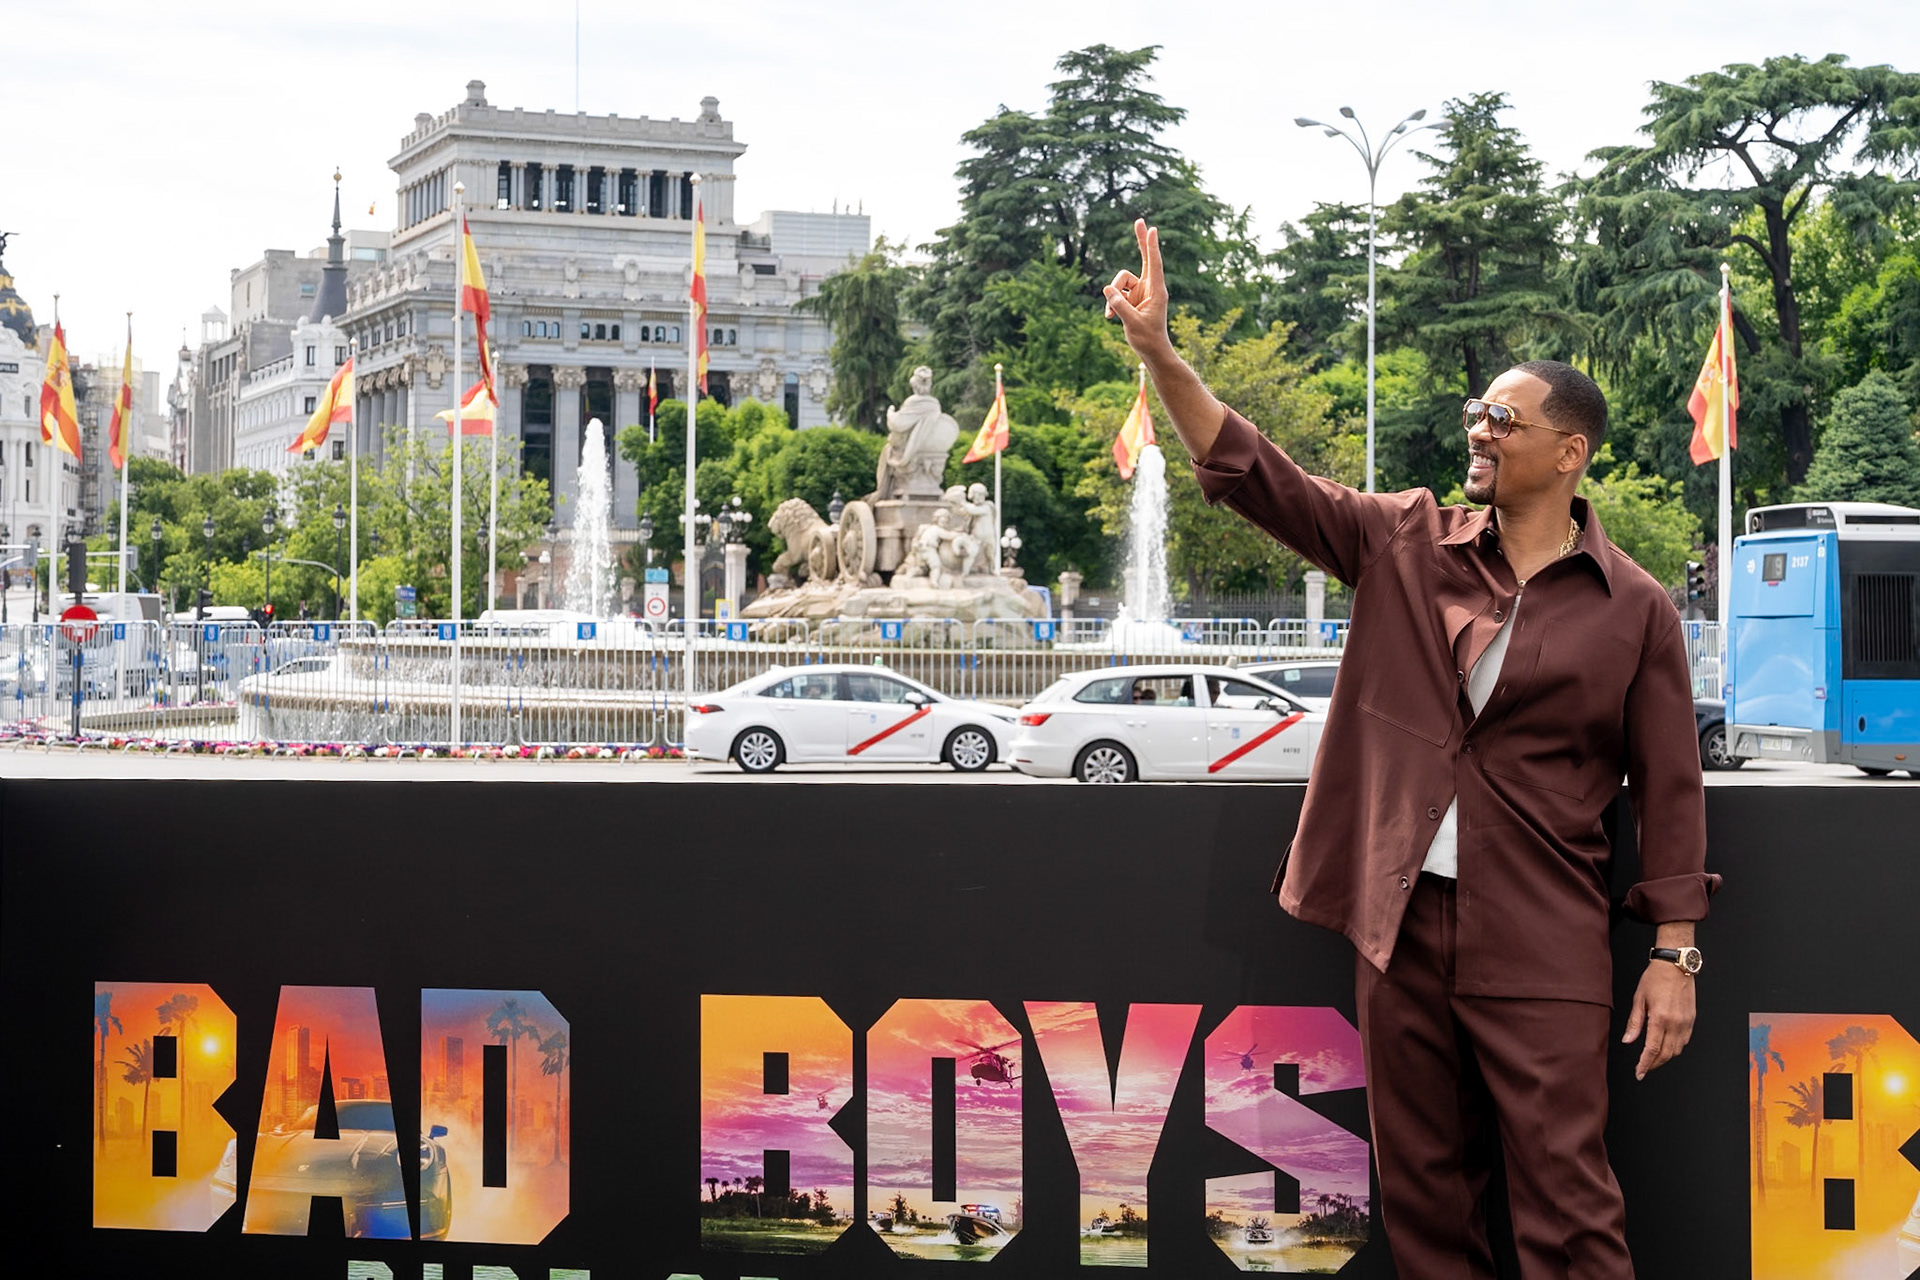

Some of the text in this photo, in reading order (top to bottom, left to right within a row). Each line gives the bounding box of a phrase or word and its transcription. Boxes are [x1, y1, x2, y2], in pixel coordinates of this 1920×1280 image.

[1792, 556, 1809, 568] 2137
[93, 980, 1370, 1274] BAD BOYS
